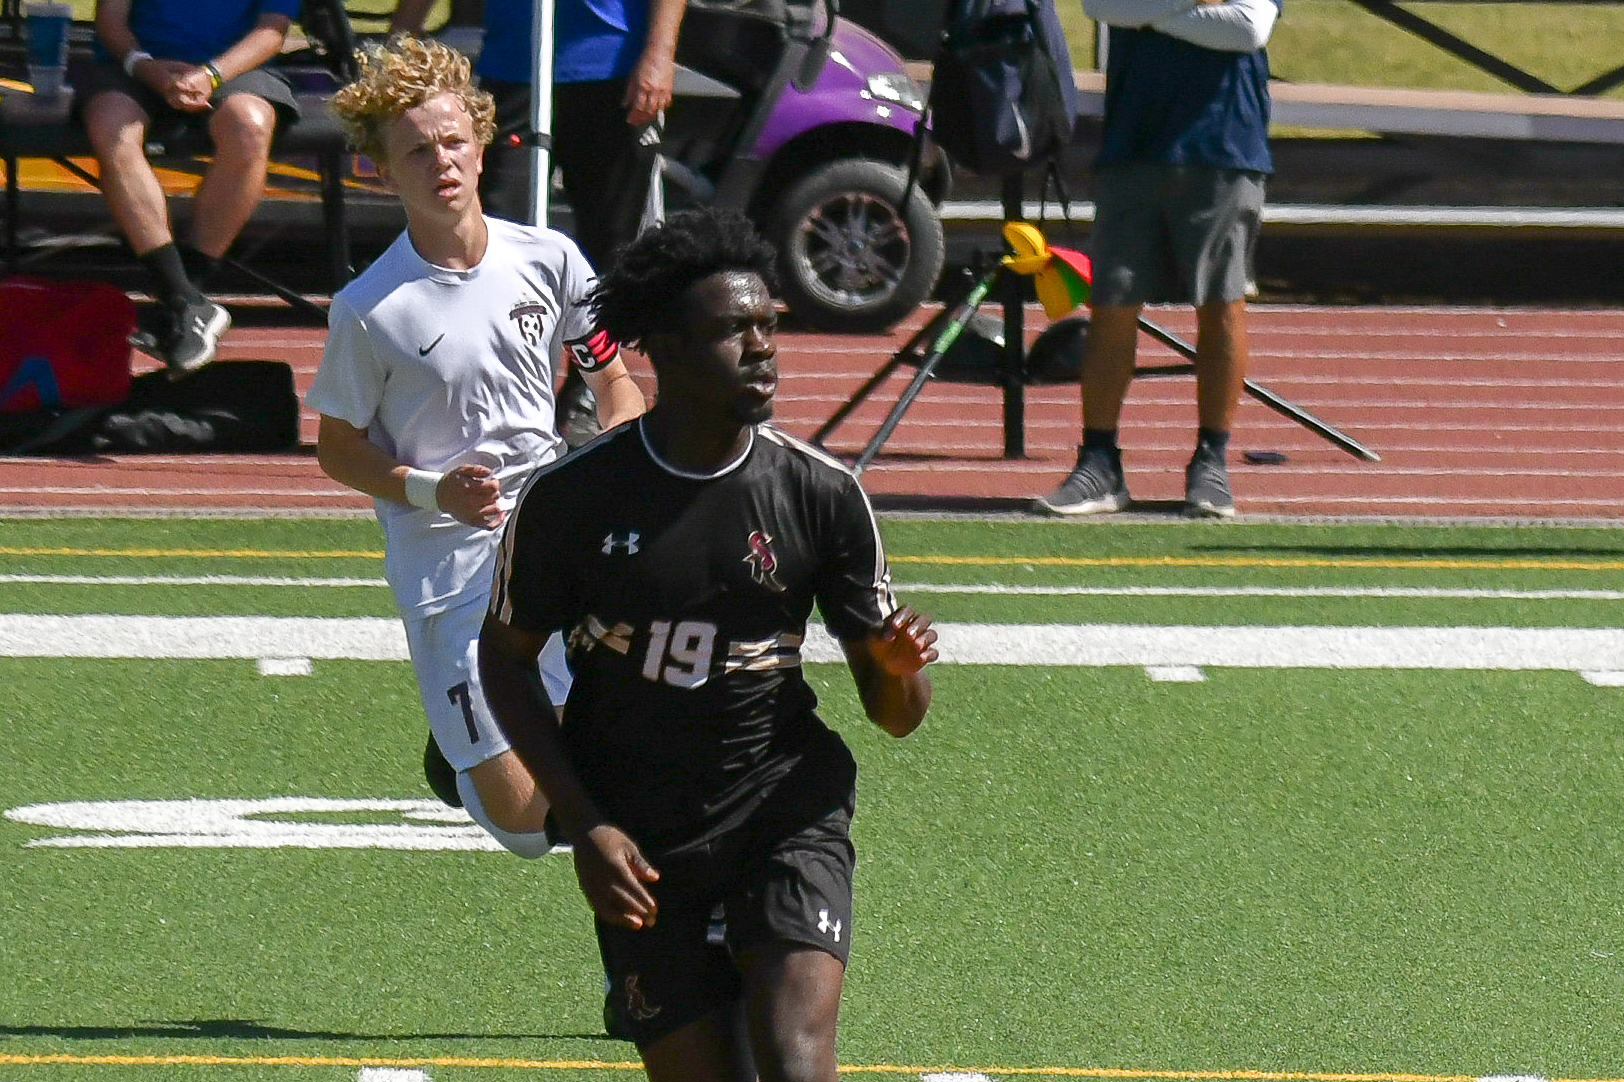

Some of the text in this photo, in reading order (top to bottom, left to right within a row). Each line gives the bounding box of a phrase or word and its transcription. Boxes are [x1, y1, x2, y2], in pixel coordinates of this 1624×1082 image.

[571, 343, 596, 369] C
[641, 620, 717, 690] 19
[447, 681, 479, 744] 7
